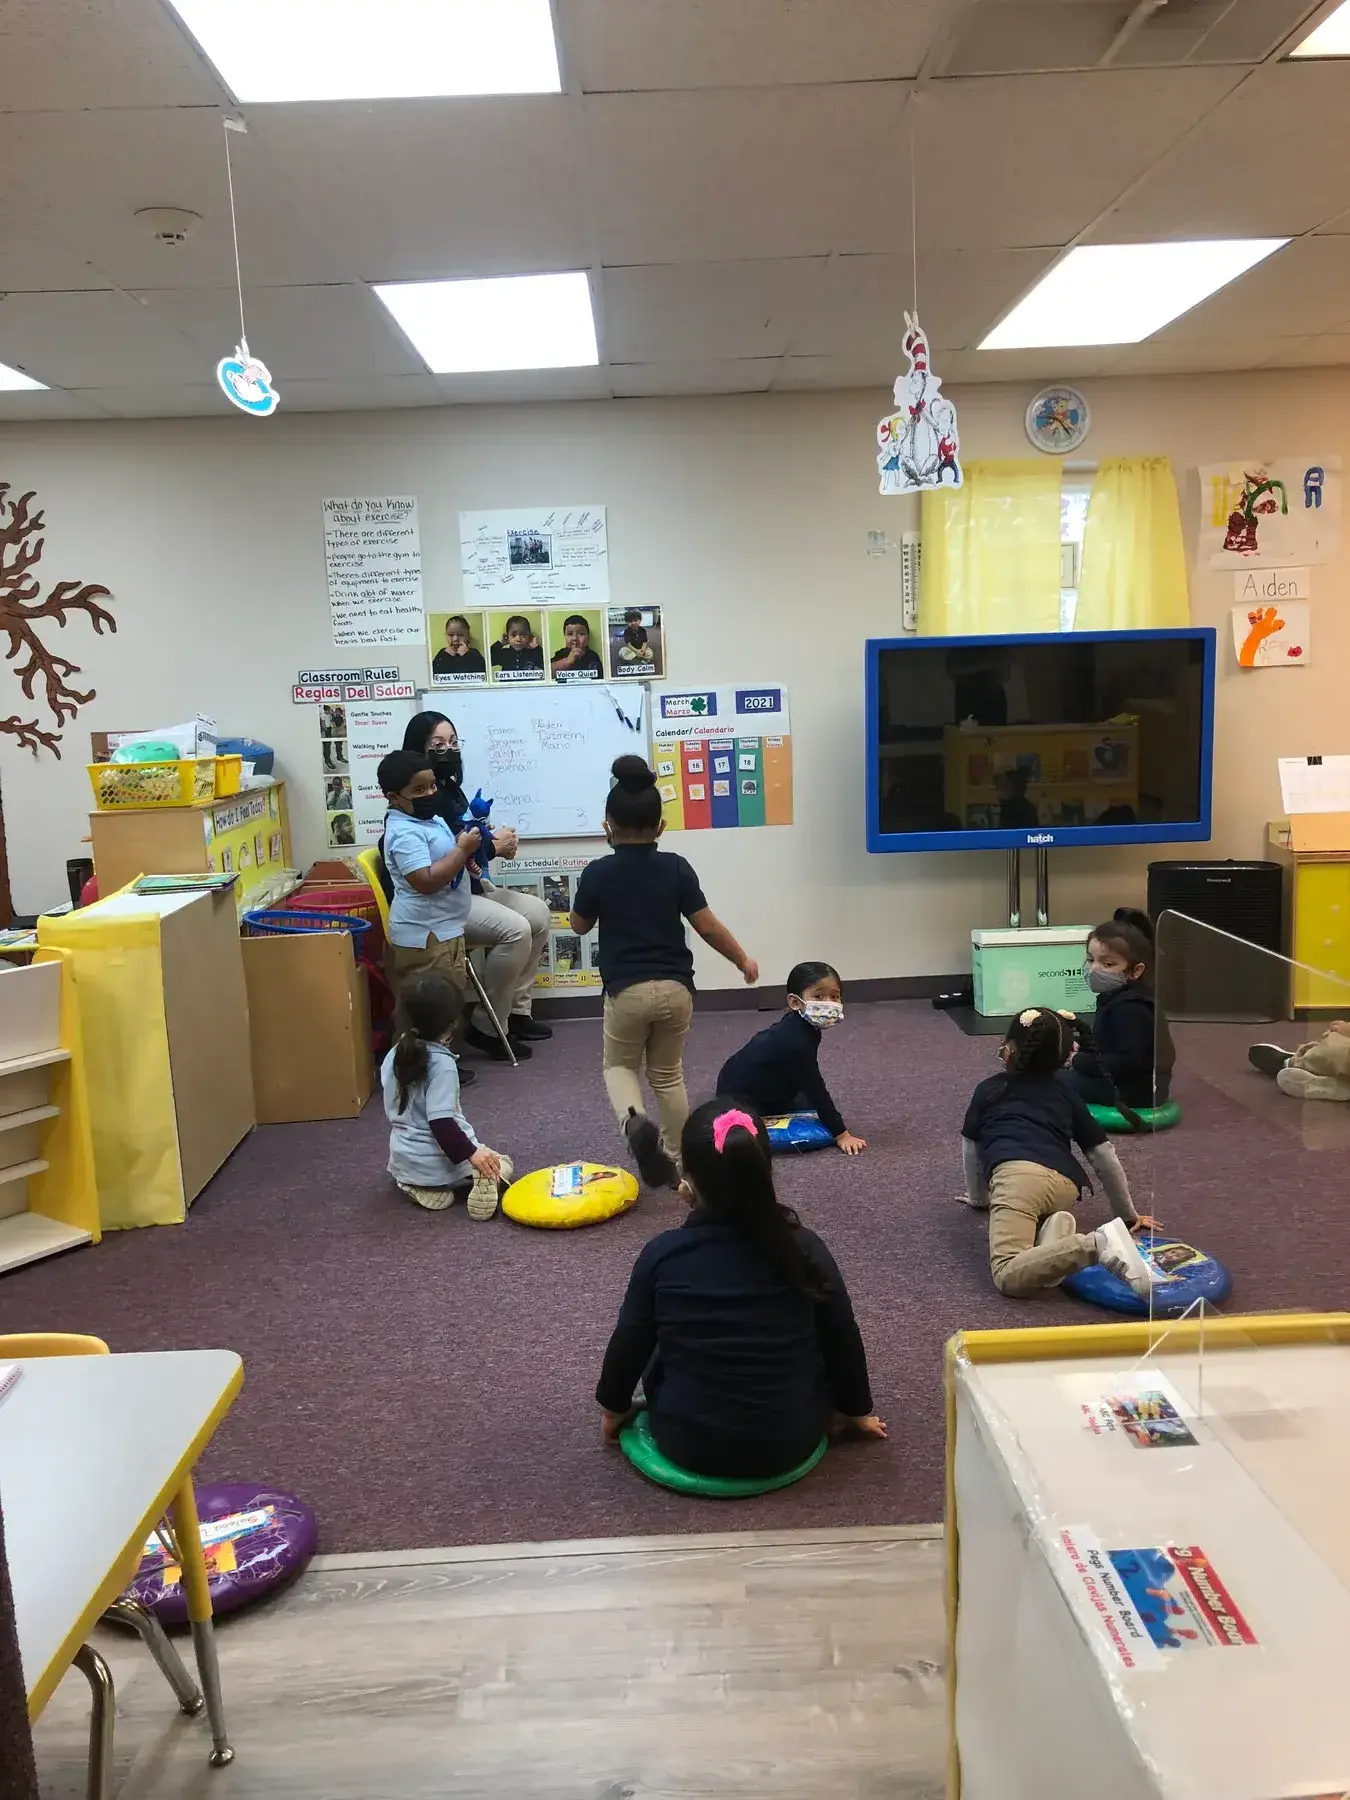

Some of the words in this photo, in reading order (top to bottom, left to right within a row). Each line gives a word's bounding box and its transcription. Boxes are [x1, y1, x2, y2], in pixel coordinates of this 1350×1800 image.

[323, 500, 349, 512] What
[351, 498, 363, 511] do
[333, 514, 361, 523] about
[365, 511, 410, 522] exercise?
[376, 528, 415, 538] different
[507, 528, 541, 537] Exercise
[326, 540, 349, 550] types
[350, 539, 361, 547] of
[363, 538, 399, 546] exercise
[377, 551, 392, 560] the
[393, 552, 410, 562] gym
[411, 550, 421, 558] to
[361, 569, 400, 578] different
[390, 576, 420, 584] exercise
[1243, 573, 1298, 598] Aiden
[378, 588, 388, 596] of
[348, 610, 366, 618] need
[369, 608, 378, 617] to
[379, 606, 393, 615] eat
[395, 605, 423, 616] healthy
[373, 628, 404, 636] exercise
[495, 671, 510, 679] Ears
[511, 669, 544, 680] Listening
[557, 670, 576, 678] Voice
[577, 669, 598, 679] Quiet
[617, 666, 636, 675] Body
[637, 664, 655, 673] Calm
[300, 671, 361, 684] Classroom
[365, 669, 398, 681] Rules
[434, 674, 453, 683] Eyes
[454, 672, 486, 682] Watching
[295, 687, 340, 702] Reglas
[347, 687, 370, 699] Del
[666, 698, 690, 707] March
[745, 697, 773, 709] 2021
[370, 710, 392, 718] Touches
[666, 708, 691, 716] Marzo
[655, 726, 693, 738] Calendar/
[693, 725, 735, 735] Calendario
[352, 743, 375, 751] Walking
[692, 762, 700, 770] 16
[718, 761, 725, 769] 17
[743, 759, 751, 767] 18
[358, 784, 374, 792] Quiet
[358, 818, 383, 826] Listening
[517, 812, 531, 832] 5
[576, 807, 589, 828] 3
[1027, 833, 1054, 844] hatch
[501, 860, 521, 870] Daily
[524, 858, 559, 868] schedule
[563, 858, 588, 867] Rutina
[1087, 1549, 1104, 1570] Pegs
[1100, 1571, 1126, 1607] Number
[1119, 1610, 1144, 1639] Board
[1188, 1566, 1228, 1615] Number
[1218, 1615, 1245, 1645] Boar
[1075, 1562, 1087, 1574] de
[1083, 1576, 1109, 1613] Clavijas
[1103, 1615, 1136, 1669] Numerales
